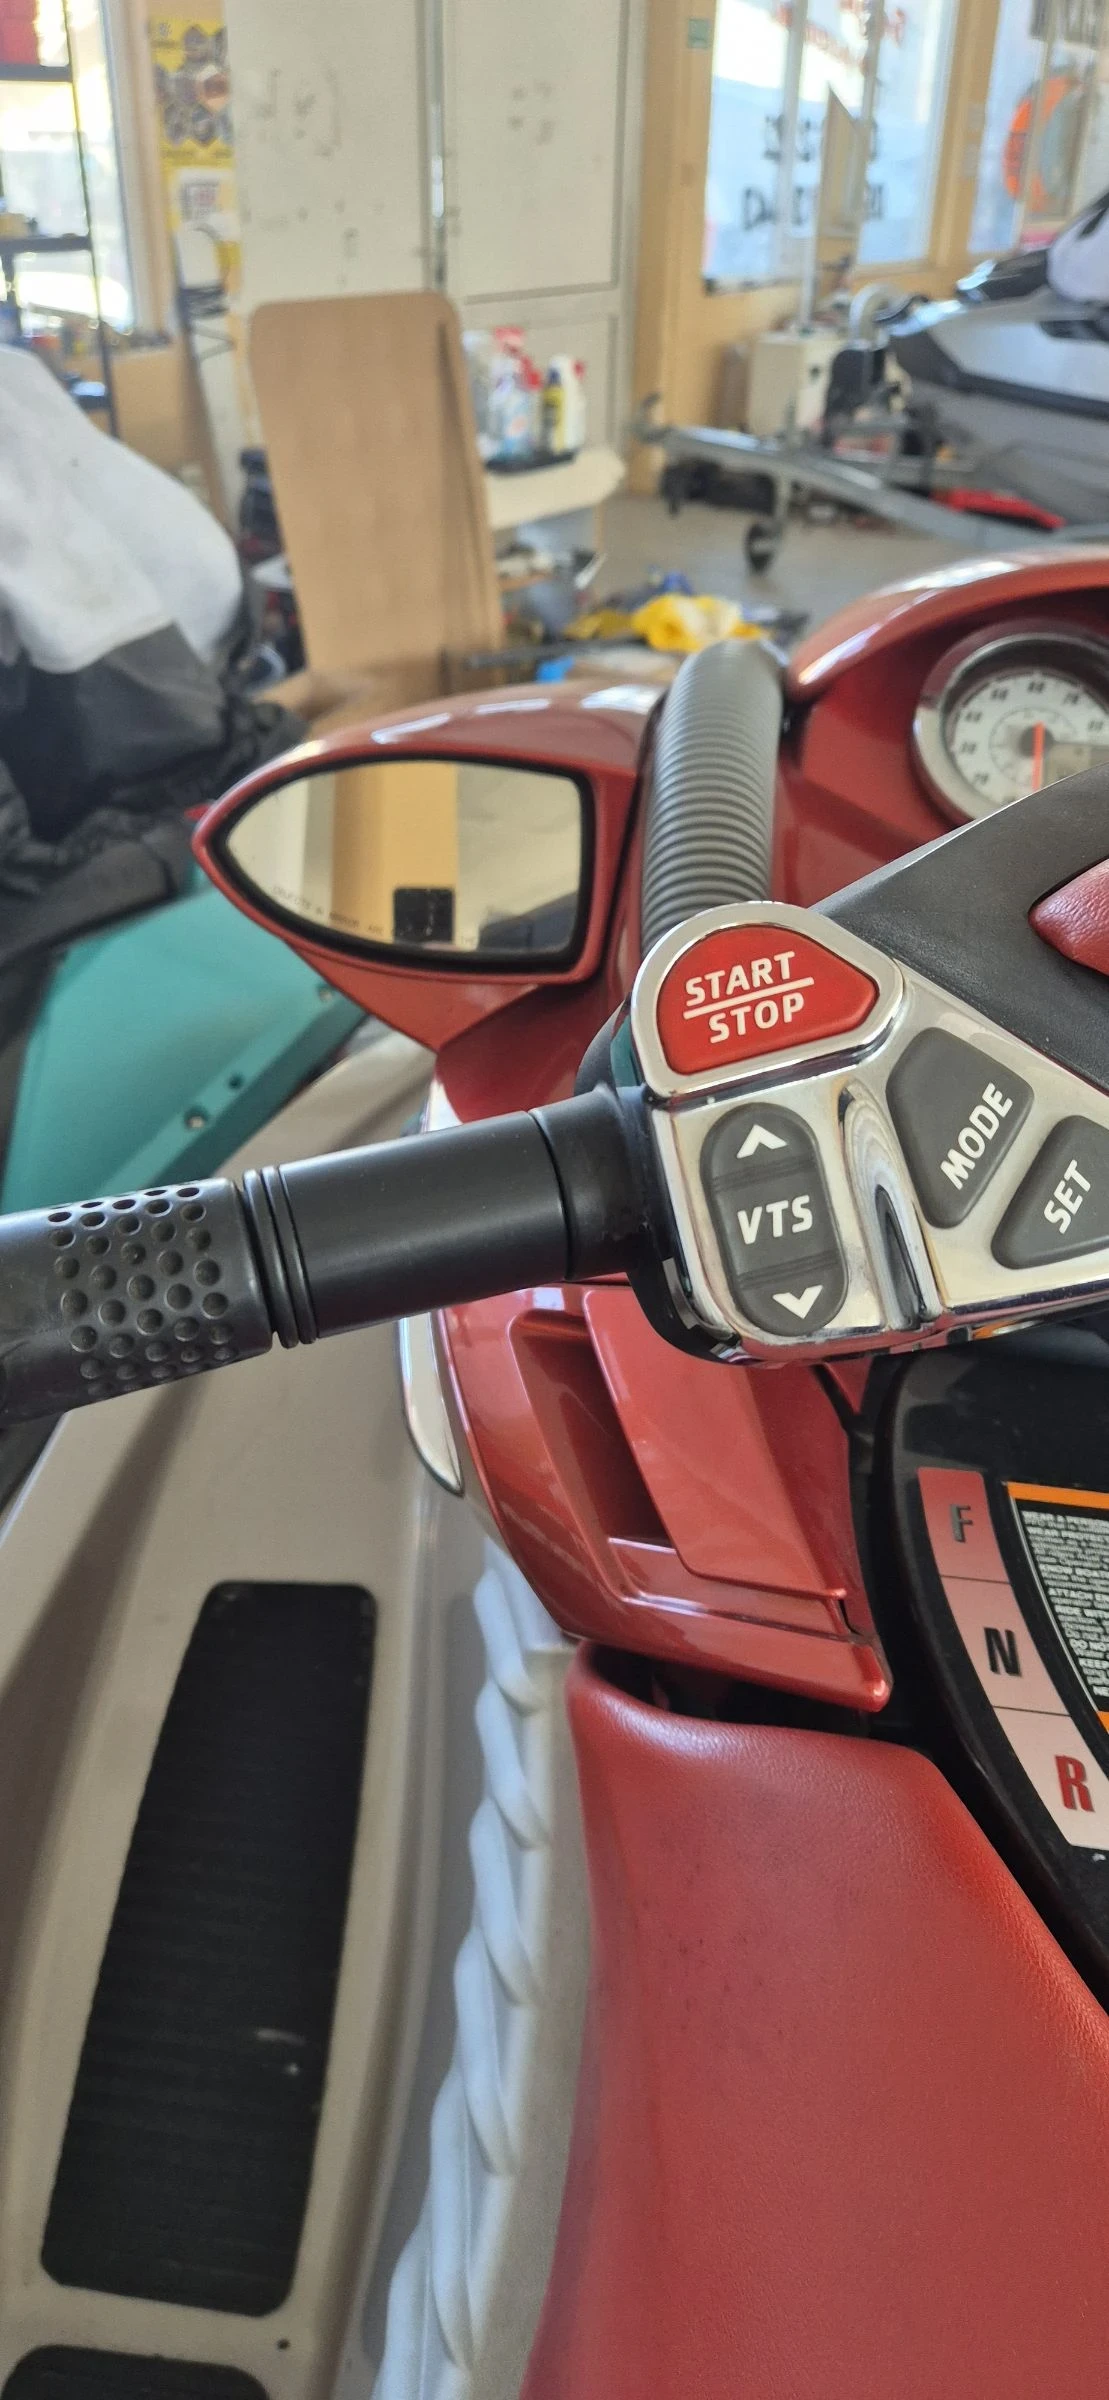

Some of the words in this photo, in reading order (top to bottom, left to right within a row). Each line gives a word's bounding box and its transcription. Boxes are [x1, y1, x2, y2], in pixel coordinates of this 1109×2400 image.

[684, 952, 797, 1007] START
[709, 991, 805, 1044] STOP
[940, 1082, 1014, 1190] MODE
[737, 1195, 813, 1245] VTS
[1044, 1159, 1091, 1235] SET
[948, 1503, 973, 1544] F
[983, 1627, 1021, 1677] N
[1054, 1754, 1095, 1813] R
